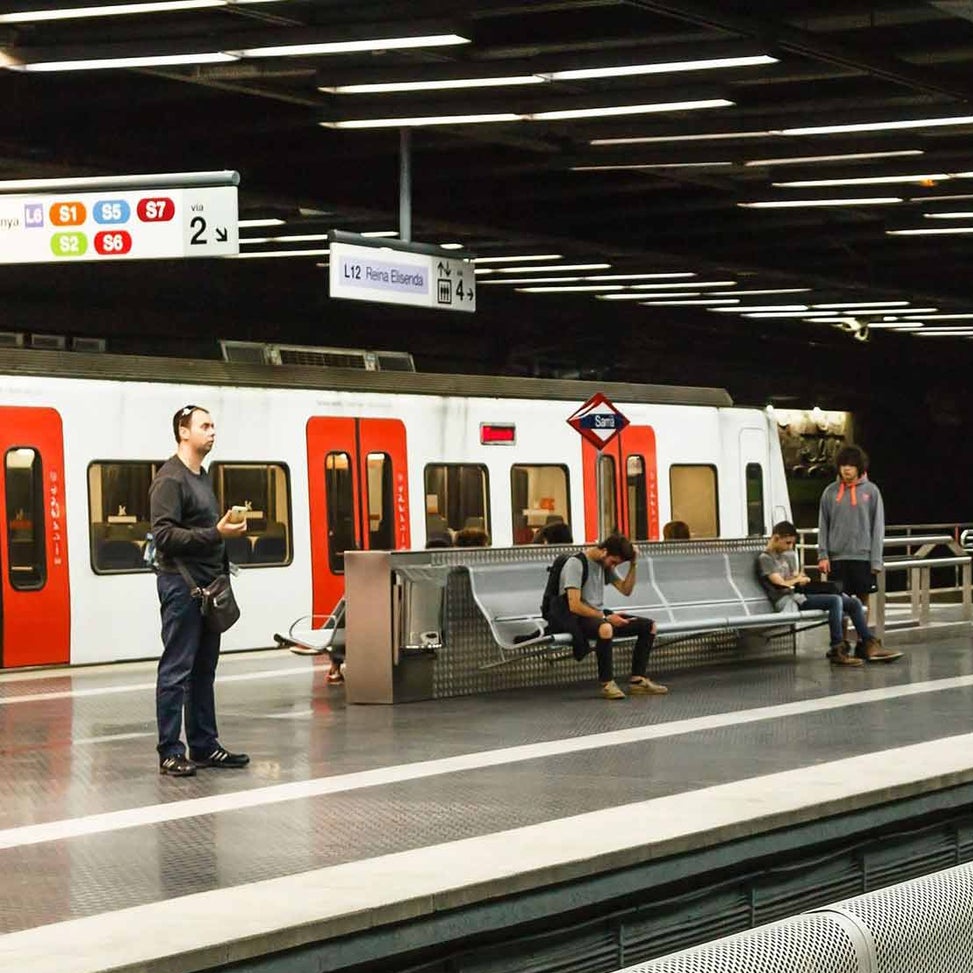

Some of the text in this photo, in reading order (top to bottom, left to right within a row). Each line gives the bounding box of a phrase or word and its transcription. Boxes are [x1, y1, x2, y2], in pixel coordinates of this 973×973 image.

[26, 207, 42, 223] L6
[59, 205, 77, 222] S1
[102, 203, 121, 220] S5
[145, 201, 166, 218] S7
[191, 203, 204, 212] via
[190, 216, 207, 245] 2
[59, 234, 123, 252] S2 S6
[344, 264, 424, 287] L12 Reina Elisenda
[456, 279, 464, 301] 4
